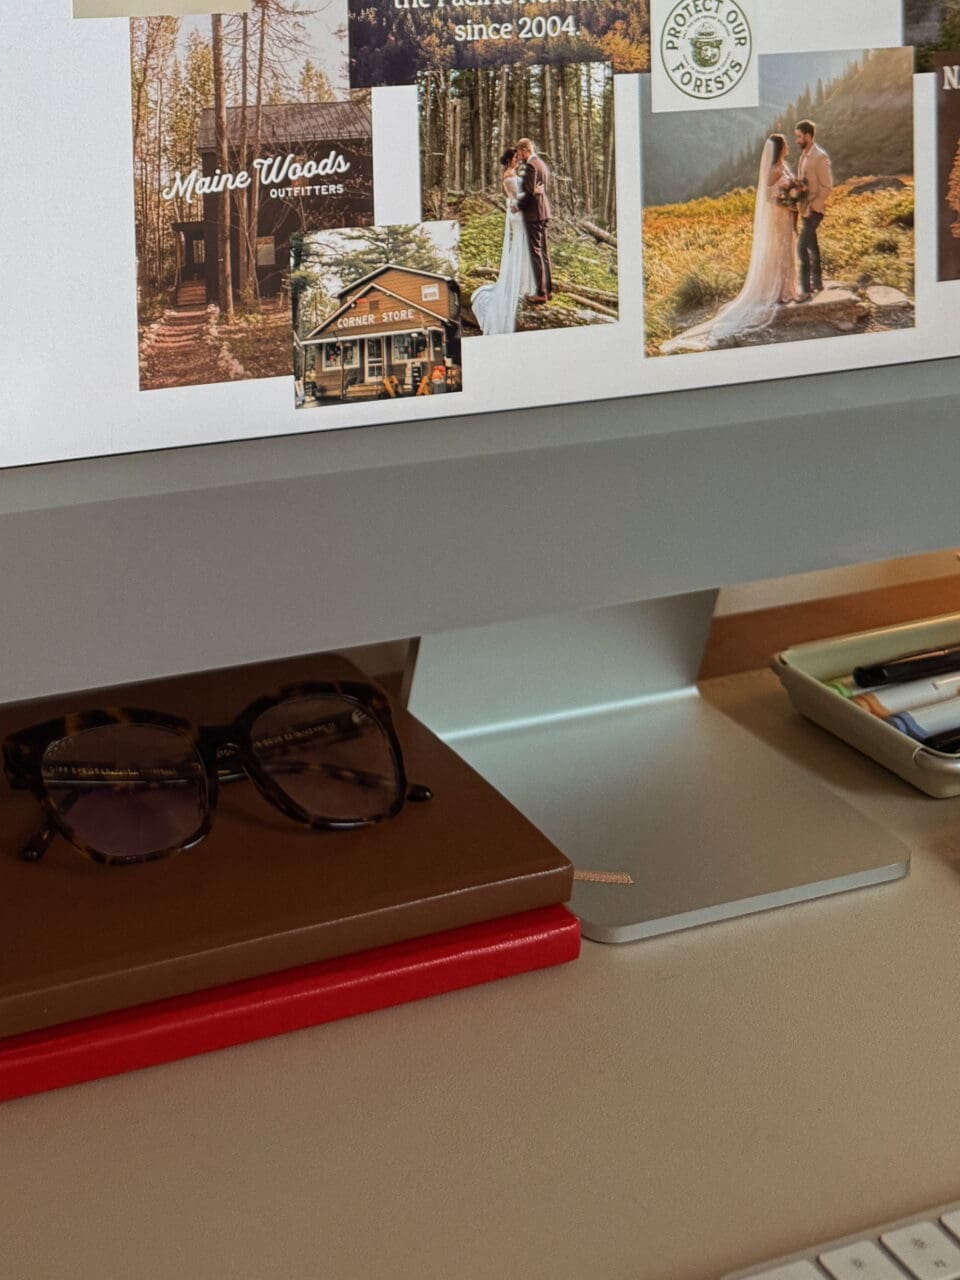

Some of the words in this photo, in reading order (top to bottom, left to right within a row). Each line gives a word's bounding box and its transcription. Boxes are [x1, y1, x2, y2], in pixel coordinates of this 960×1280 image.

[454, 19, 513, 42] since
[517, 14, 581, 39] 2004.
[726, 9, 748, 47] OUR
[671, 59, 743, 94] FORESTS
[161, 168, 252, 204] Maine
[252, 150, 351, 185] Woods
[269, 183, 345, 199] OUTFITTERS
[336, 313, 376, 329] CORNER
[381, 308, 415, 323] STORE
